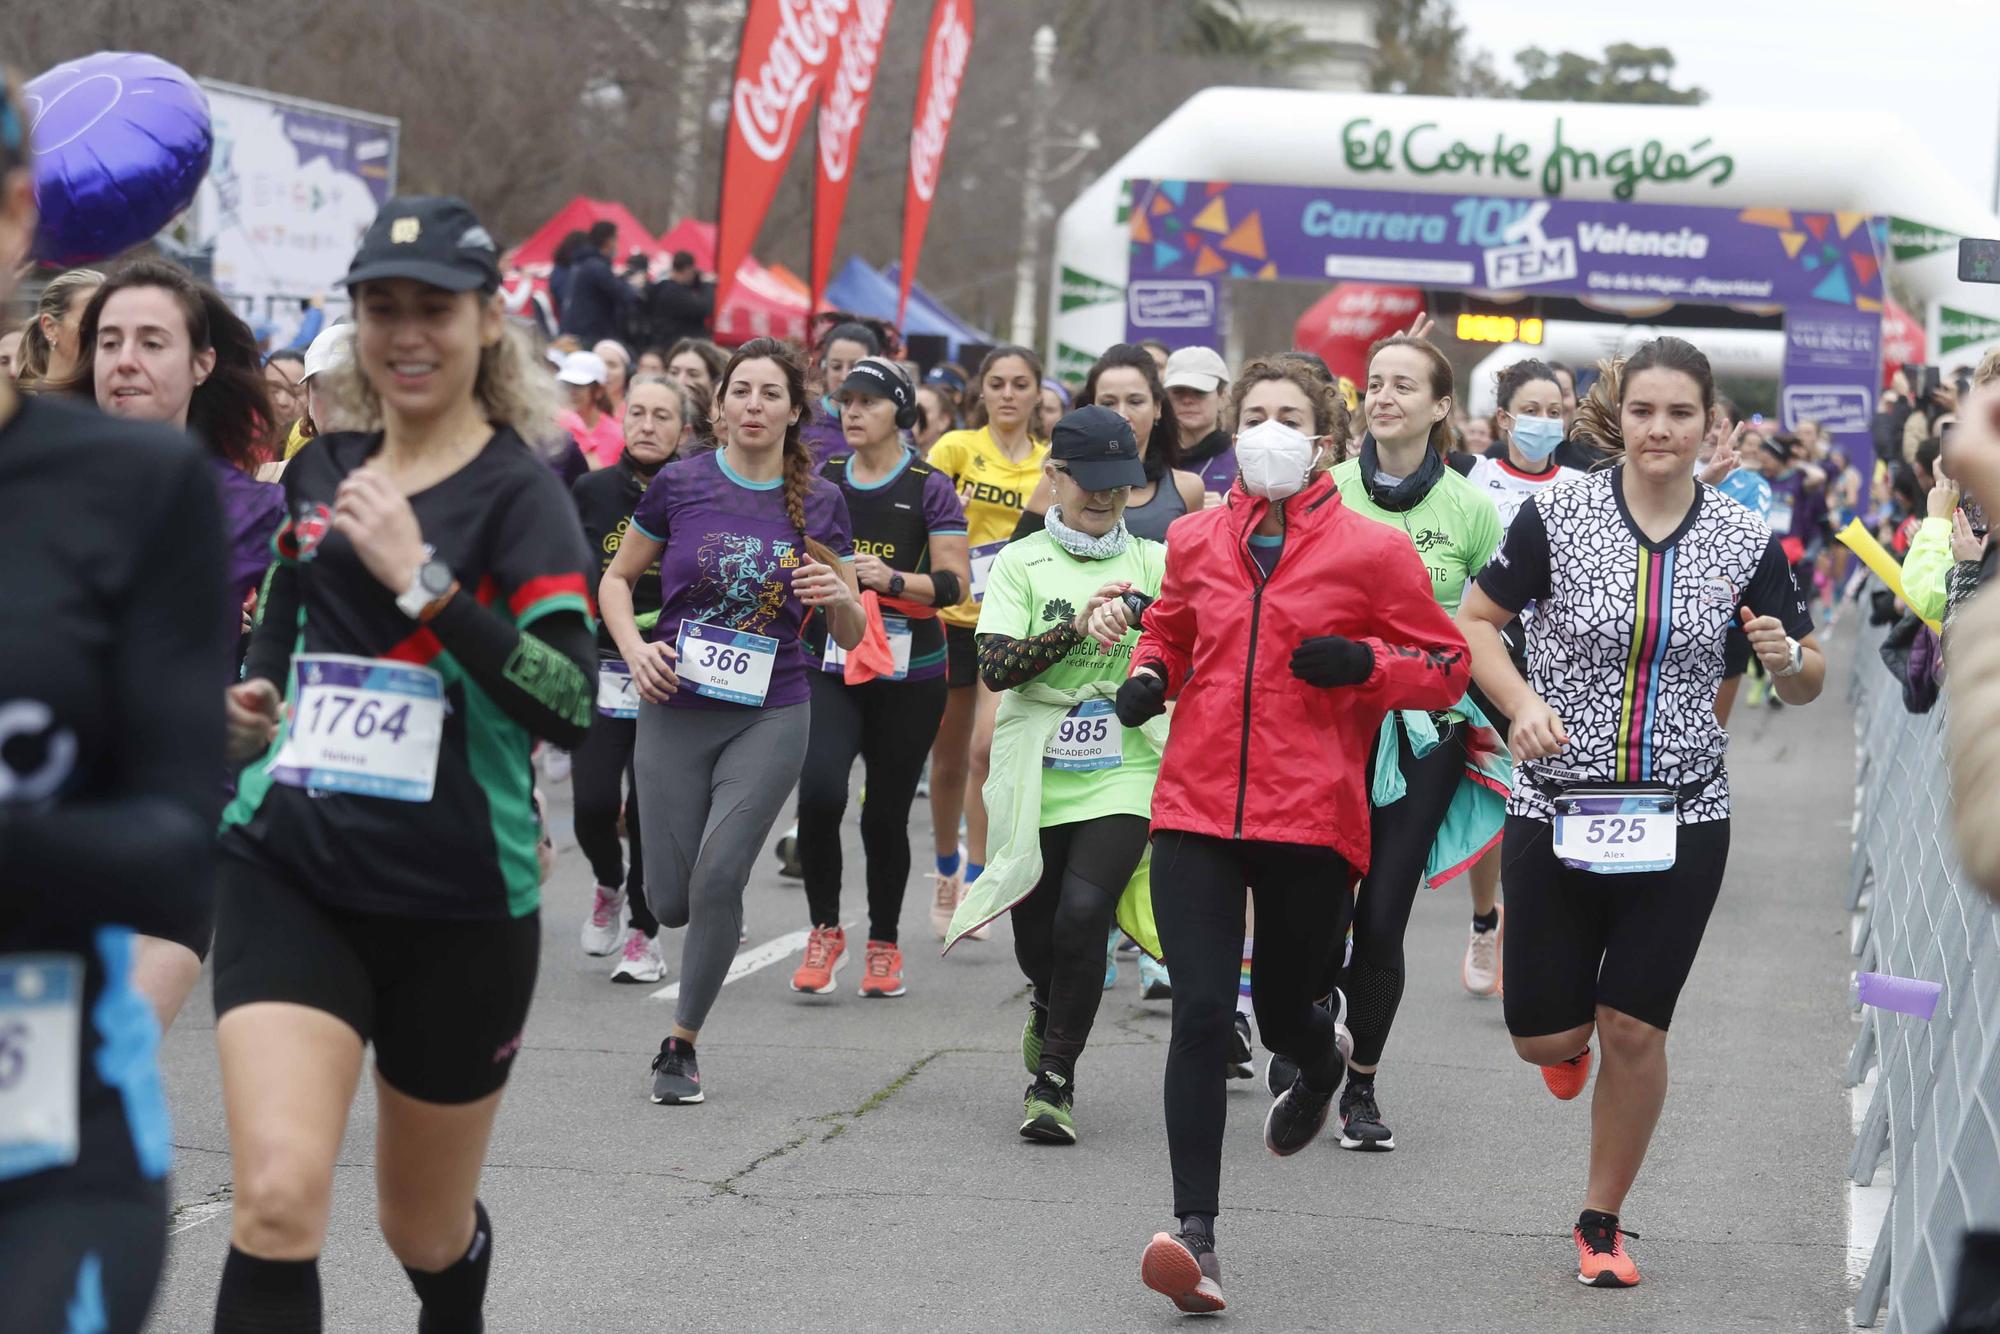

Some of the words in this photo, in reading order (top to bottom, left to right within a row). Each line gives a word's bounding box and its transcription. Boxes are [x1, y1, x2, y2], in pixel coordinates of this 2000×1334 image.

[1342, 117, 1394, 172] El
[1402, 122, 1531, 178] Corte
[1542, 117, 1735, 200] Inglés
[1301, 200, 1448, 243] Carrera
[1577, 220, 1710, 260] Valencia
[699, 645, 751, 675] 366
[710, 675, 729, 686] Rata
[311, 694, 413, 744] 1764
[1058, 718, 1108, 744] 985
[1045, 746, 1102, 757] CHICADEORO
[1585, 817, 1647, 844] 525
[1603, 850, 1625, 860] Alex
